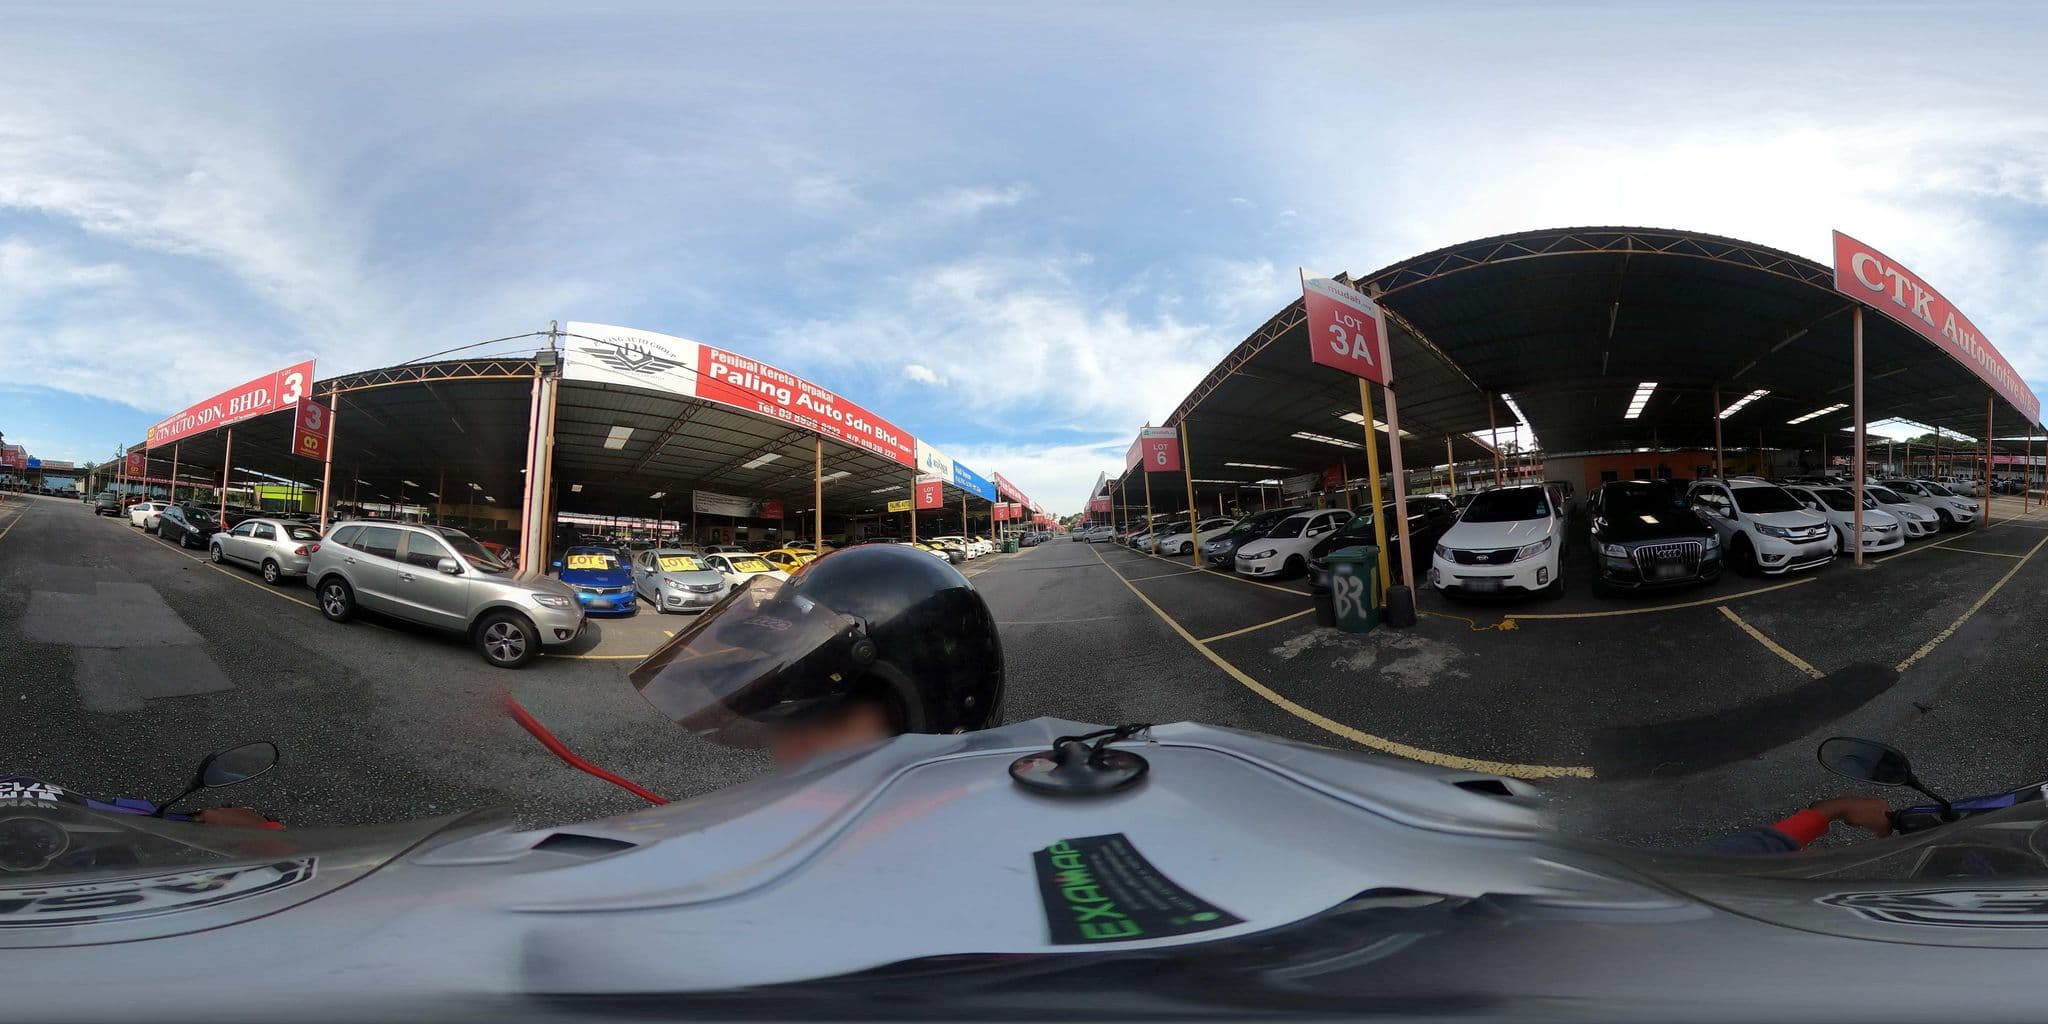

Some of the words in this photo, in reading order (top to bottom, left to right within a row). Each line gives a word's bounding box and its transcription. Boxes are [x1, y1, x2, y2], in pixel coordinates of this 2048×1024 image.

[1334, 310, 1362, 331] LOT
[1851, 252, 1935, 328] CTK
[1941, 311, 2019, 394] Automotive
[1329, 324, 1374, 366] 3A
[282, 372, 303, 405] 3
[710, 349, 758, 373] Penjual
[760, 365, 795, 387] Kereta
[796, 379, 834, 404] Terpakai
[170, 415, 195, 434] AUTO
[197, 403, 225, 426] SDN.
[230, 388, 272, 415] BHD.
[305, 404, 322, 430] 3
[709, 363, 792, 406] Paling
[796, 393, 843, 421] Auto
[845, 412, 872, 435] Sdn
[875, 426, 897, 447] Bhd
[1157, 451, 1167, 465] 6
[925, 493, 933, 504] 5
[570, 556, 594, 565] LOT
[1044, 839, 1144, 939] EXAMAP
